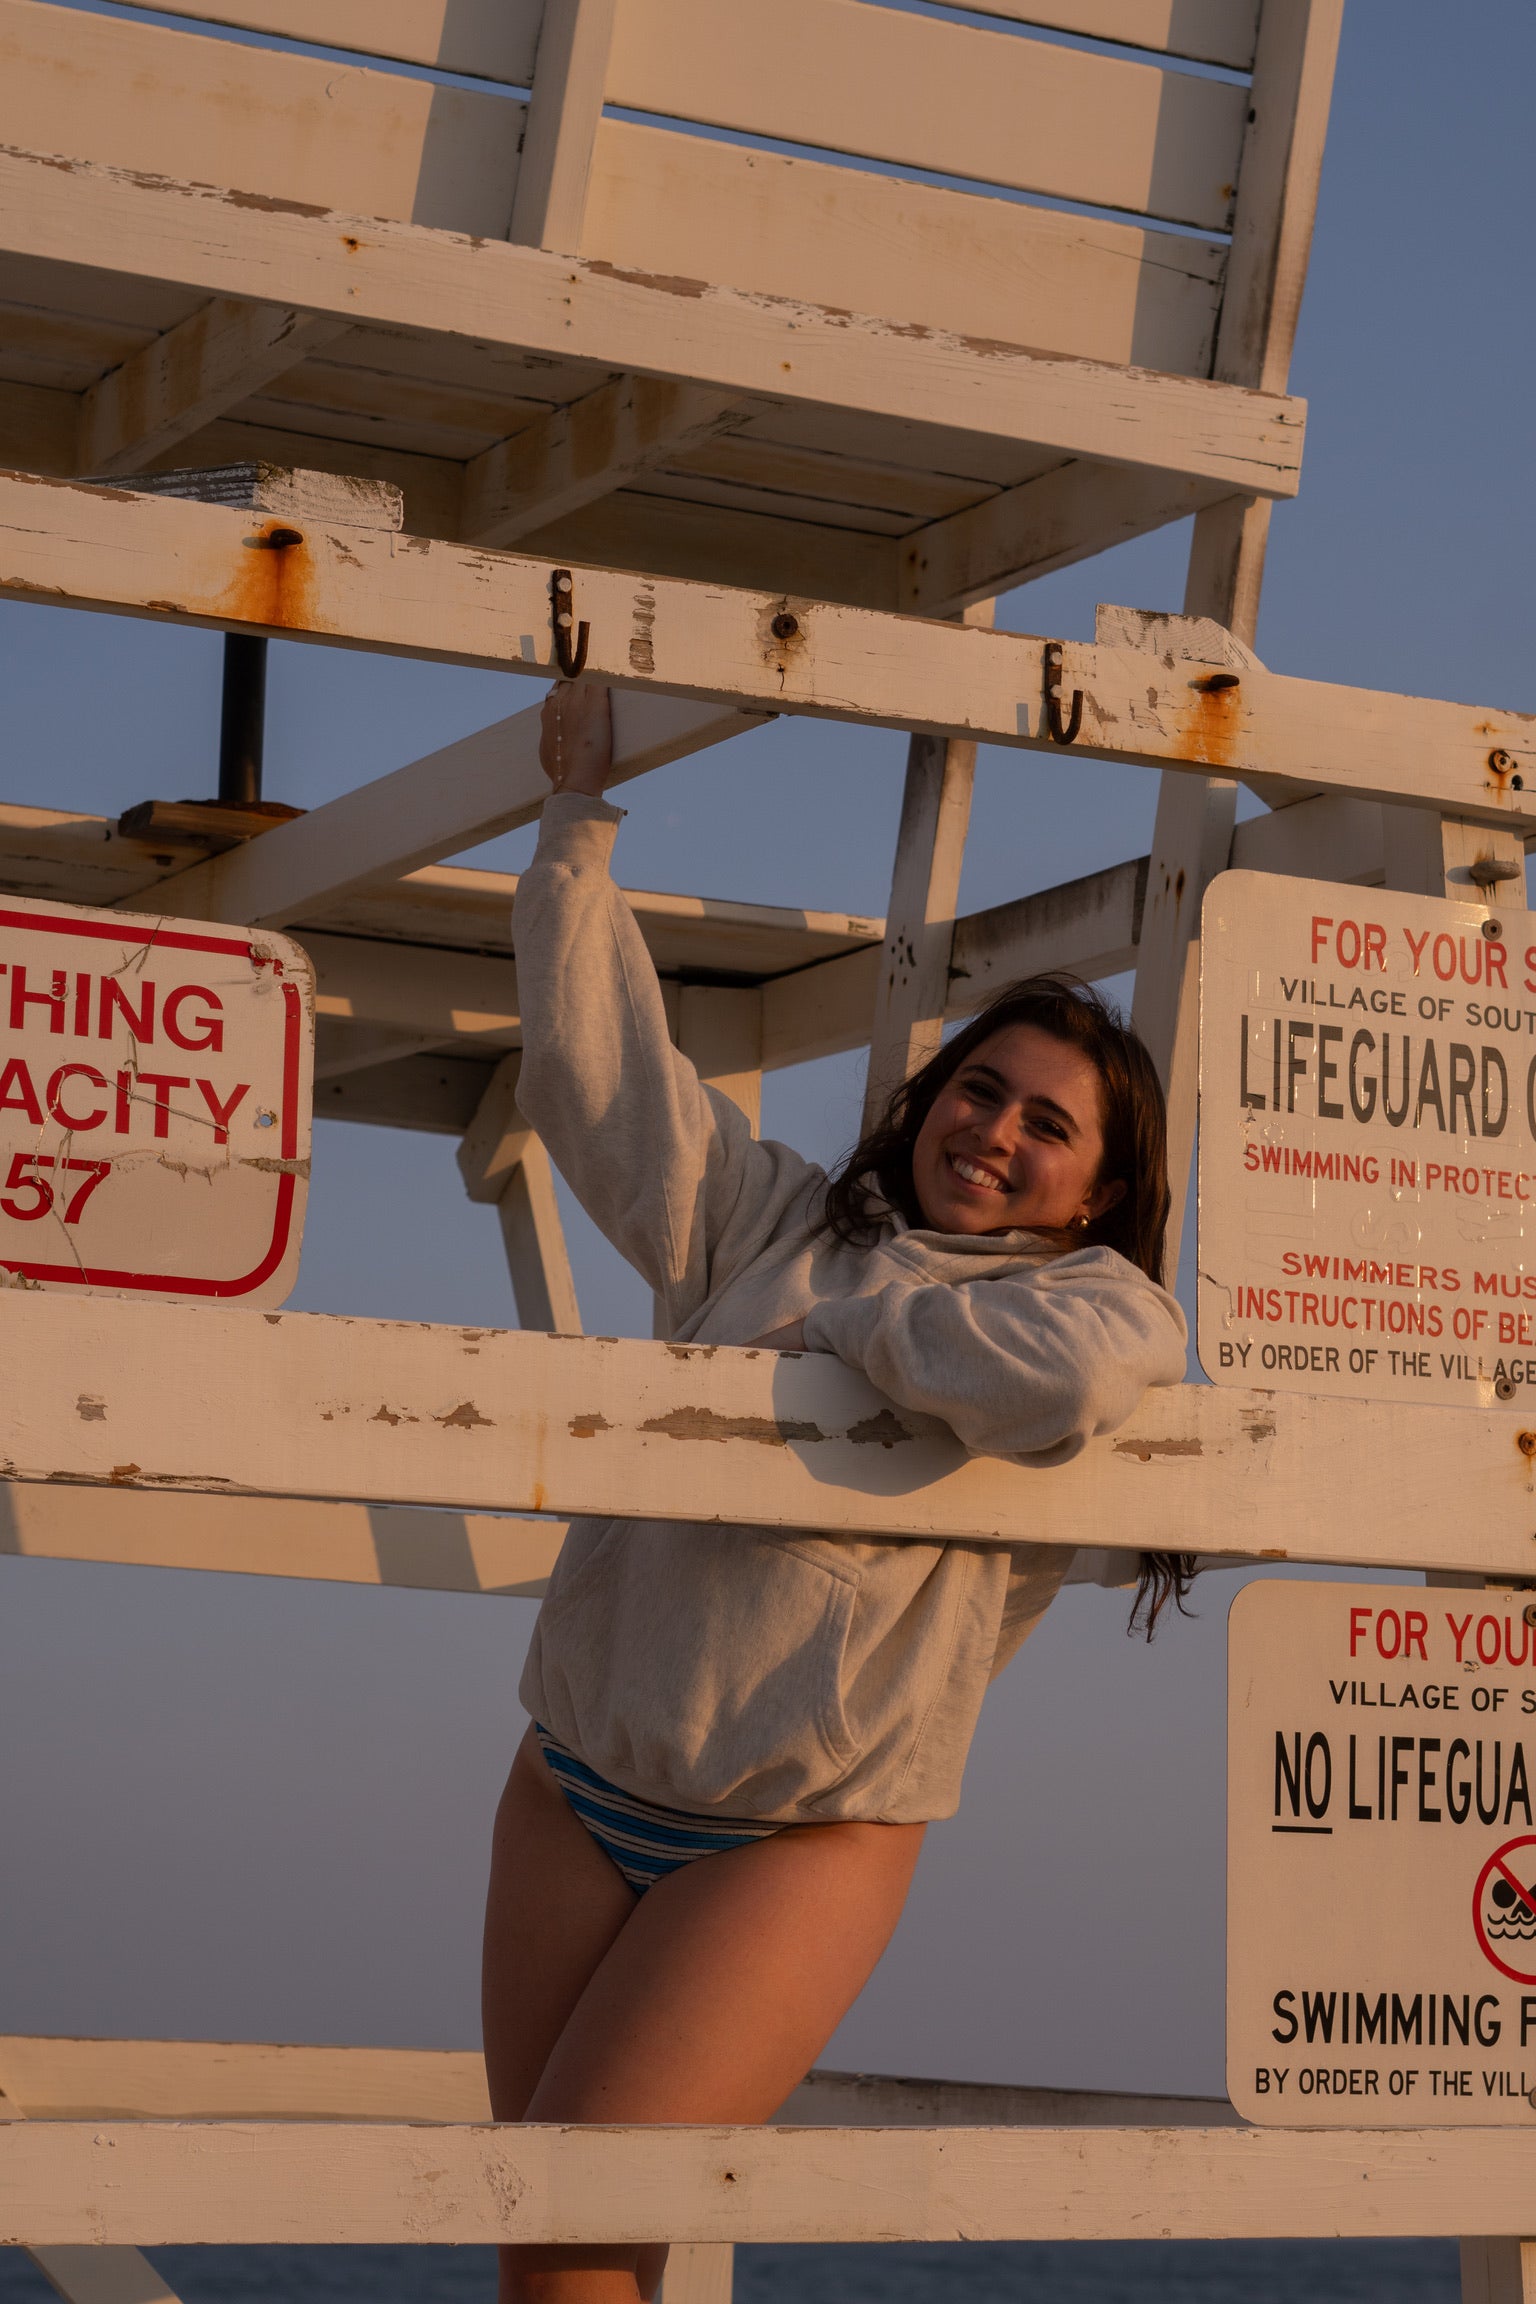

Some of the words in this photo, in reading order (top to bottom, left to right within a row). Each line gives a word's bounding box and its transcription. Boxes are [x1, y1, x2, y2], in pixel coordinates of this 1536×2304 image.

[1312, 916, 1386, 970] FOR
[1403, 928, 1508, 989] YOUR
[0, 964, 223, 1052] HING
[1280, 977, 1406, 1016] VILLAGE
[1418, 997, 1454, 1021] OF
[1466, 1003, 1536, 1034] SOUT
[0, 1058, 250, 1144] ACITY
[1240, 1015, 1509, 1137] LIFEGUARD
[0, 1153, 111, 1224] 57
[1243, 1144, 1379, 1183] SWIMMING
[1391, 1159, 1415, 1188] IN
[1426, 1163, 1536, 1200] PROTEC
[1282, 1253, 1460, 1292] SWIMMERS
[1474, 1272, 1536, 1299] MUS
[1238, 1286, 1443, 1337] INSTRUCTIONS
[1453, 1308, 1488, 1340] OF
[1499, 1312, 1536, 1345] BE
[1220, 1342, 1252, 1368] BY
[1262, 1344, 1339, 1372] ORDER
[1349, 1349, 1378, 1373] OF
[1388, 1351, 1431, 1377] THE
[1440, 1354, 1536, 1384] VILLAGE
[1350, 1608, 1427, 1660] FOR
[1446, 1614, 1536, 1666] YOU
[1329, 1680, 1459, 1710] VILLAGE
[1472, 1688, 1508, 1711] OF
[1275, 1731, 1331, 1819] NO
[1349, 1735, 1532, 1825] LIFEGUA
[1272, 1990, 1501, 2047] SWIMMING
[1256, 2068, 1289, 2093] BY
[1299, 2069, 1378, 2094] ORDER
[1389, 2070, 1418, 2095] OF
[1429, 2071, 1472, 2096] THE
